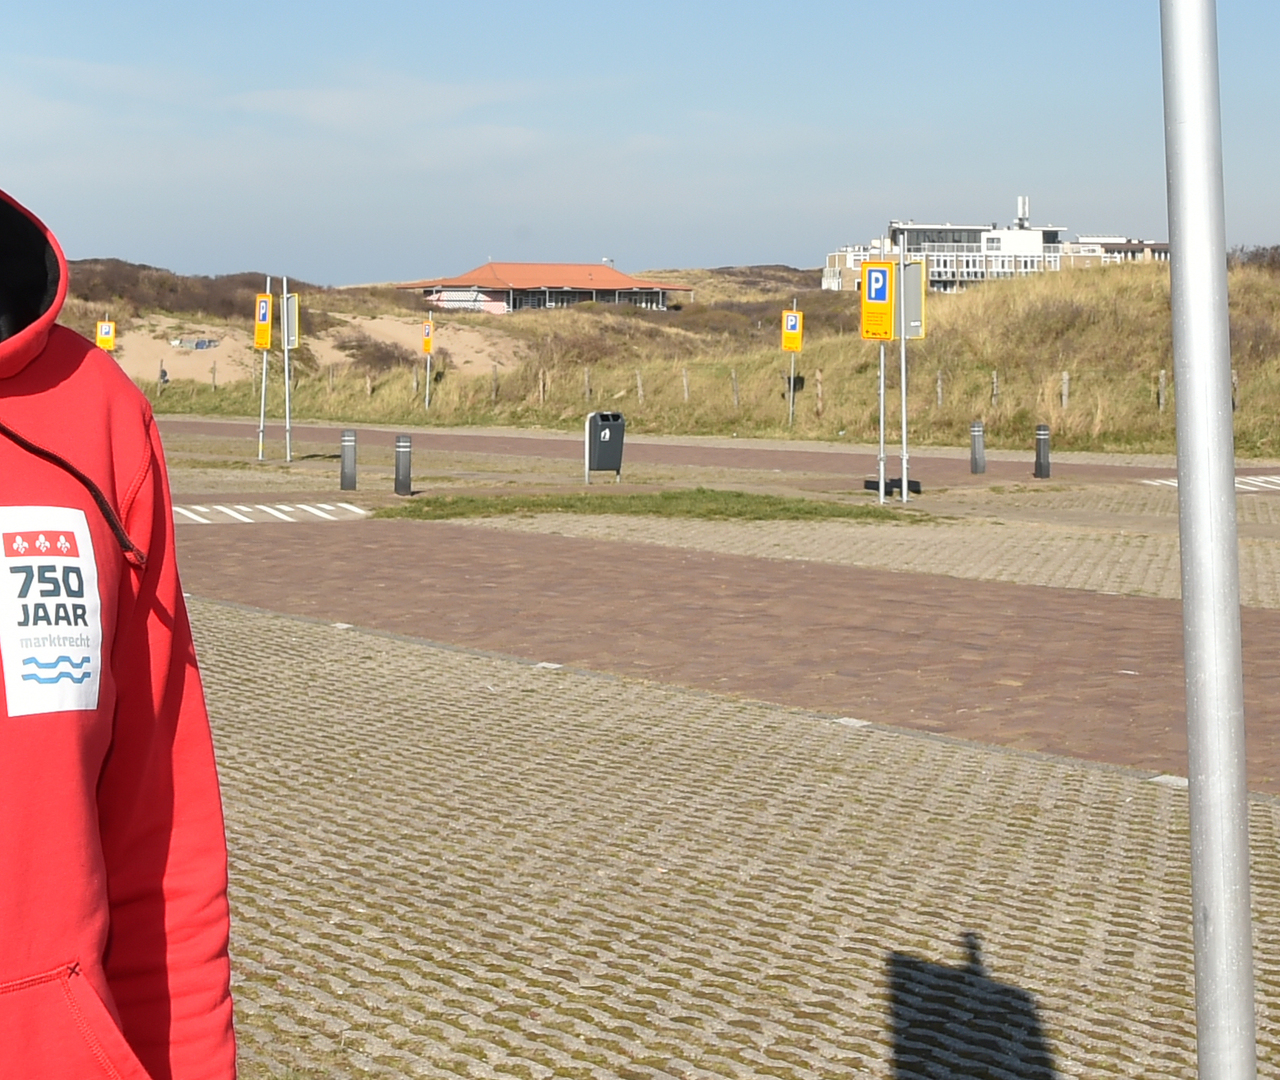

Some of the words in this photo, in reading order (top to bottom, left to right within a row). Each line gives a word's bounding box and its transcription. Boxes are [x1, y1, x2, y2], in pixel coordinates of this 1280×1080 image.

[871, 271, 883, 298] P
[259, 301, 266, 321] P
[787, 315, 796, 330] P
[9, 565, 84, 598] 750
[17, 603, 89, 627] JAAR
[19, 633, 91, 648] marktrecht
